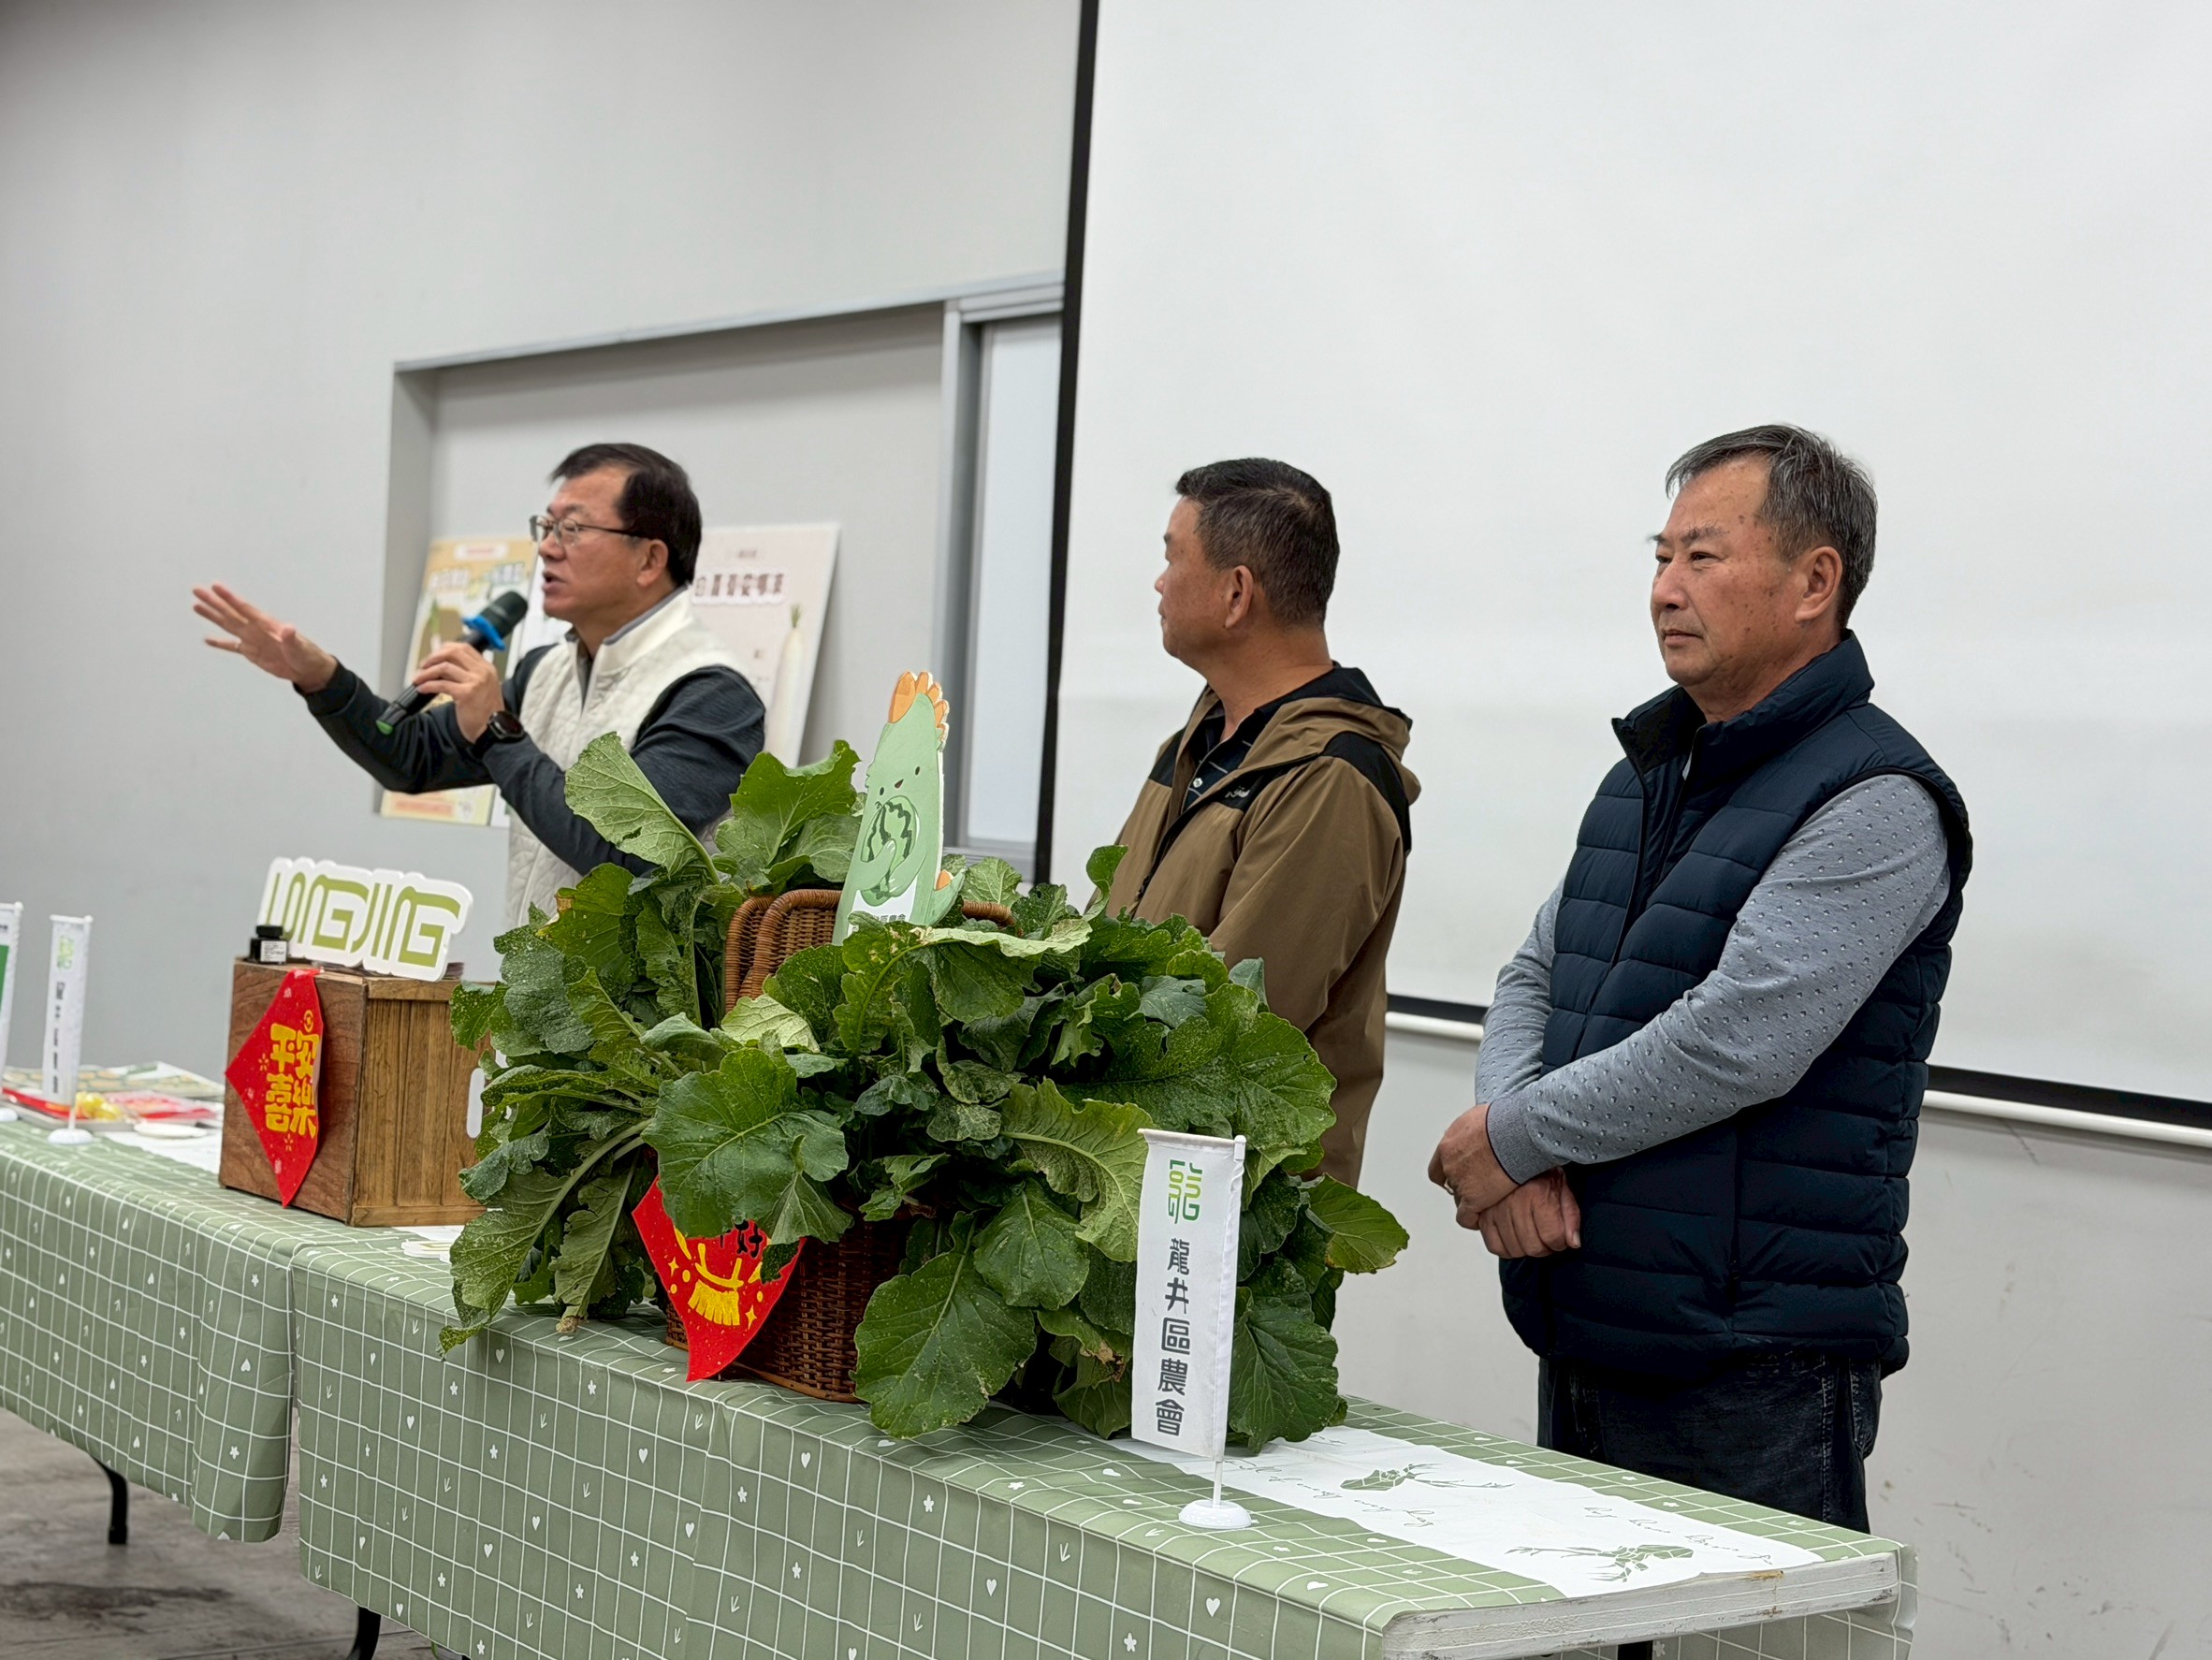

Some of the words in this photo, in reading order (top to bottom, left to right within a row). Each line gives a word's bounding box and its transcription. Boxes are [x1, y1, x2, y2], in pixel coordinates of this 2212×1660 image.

[1155, 1237, 1191, 1436] 龍井區農會
